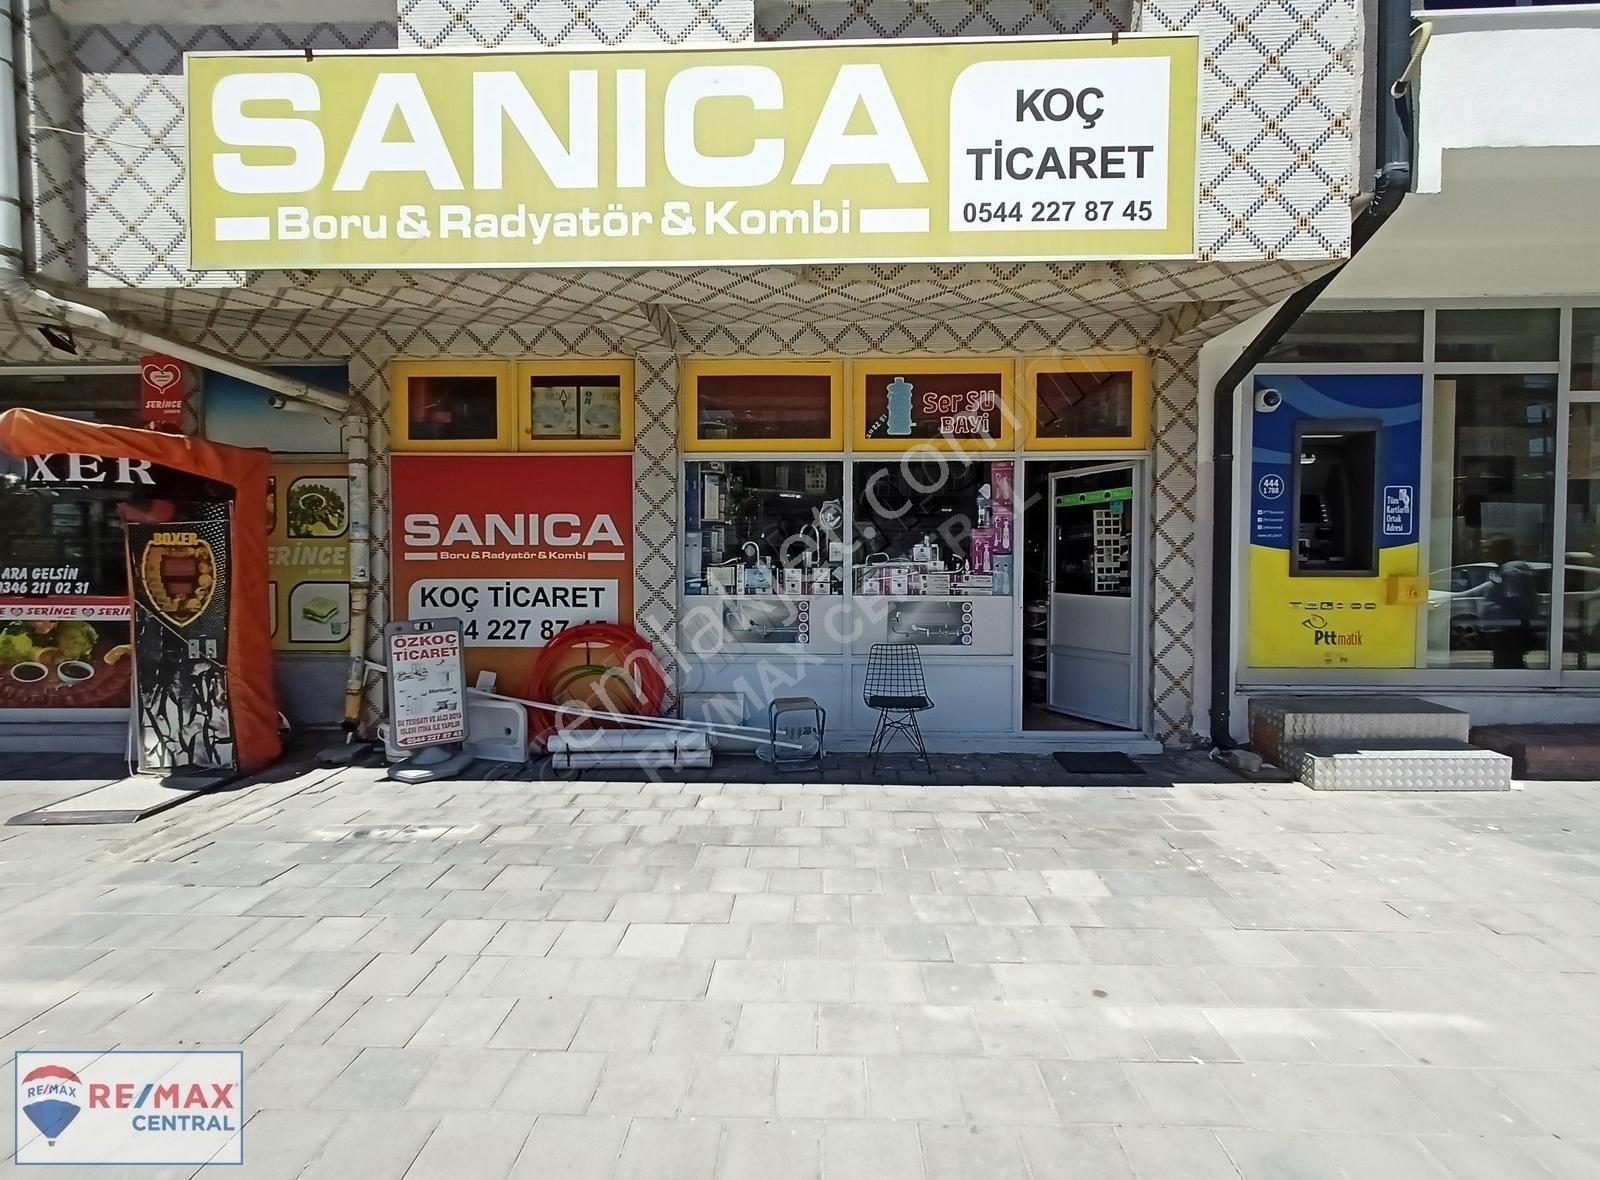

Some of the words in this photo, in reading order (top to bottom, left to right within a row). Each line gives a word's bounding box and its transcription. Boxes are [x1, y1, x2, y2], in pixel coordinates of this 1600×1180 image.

[1016, 86, 1105, 129] KOÇ
[211, 64, 929, 194] SANICA
[966, 139, 1154, 180] TİCARET
[277, 206, 387, 241] Boru
[397, 205, 432, 240] &
[440, 202, 653, 245] Radyatör
[660, 200, 696, 236] &
[707, 199, 852, 235] Kombi
[962, 201, 1023, 224] 0544
[1031, 201, 1074, 223] 227
[1084, 200, 1113, 222] 87
[1122, 200, 1153, 222] 45
[922, 392, 963, 413] Ser
[24, 452, 156, 485] XER
[1263, 479, 1280, 488] 444
[404, 513, 625, 547] SANICA
[440, 551, 470, 560] Boru
[471, 551, 481, 560] &
[482, 551, 537, 561] Radyatör
[538, 551, 548, 560] &
[549, 551, 586, 560] Kombi
[1, 567, 28, 580] ARA
[32, 564, 79, 580] GELSİN
[31, 581, 50, 594] 211
[55, 581, 71, 594] 02
[74, 581, 90, 594] 31
[420, 586, 480, 613] KOÇ
[488, 581, 606, 608] TİCARET
[26, 606, 78, 615] SERİNCE
[487, 619, 531, 640] 227
[393, 646, 459, 662] TİCARET
